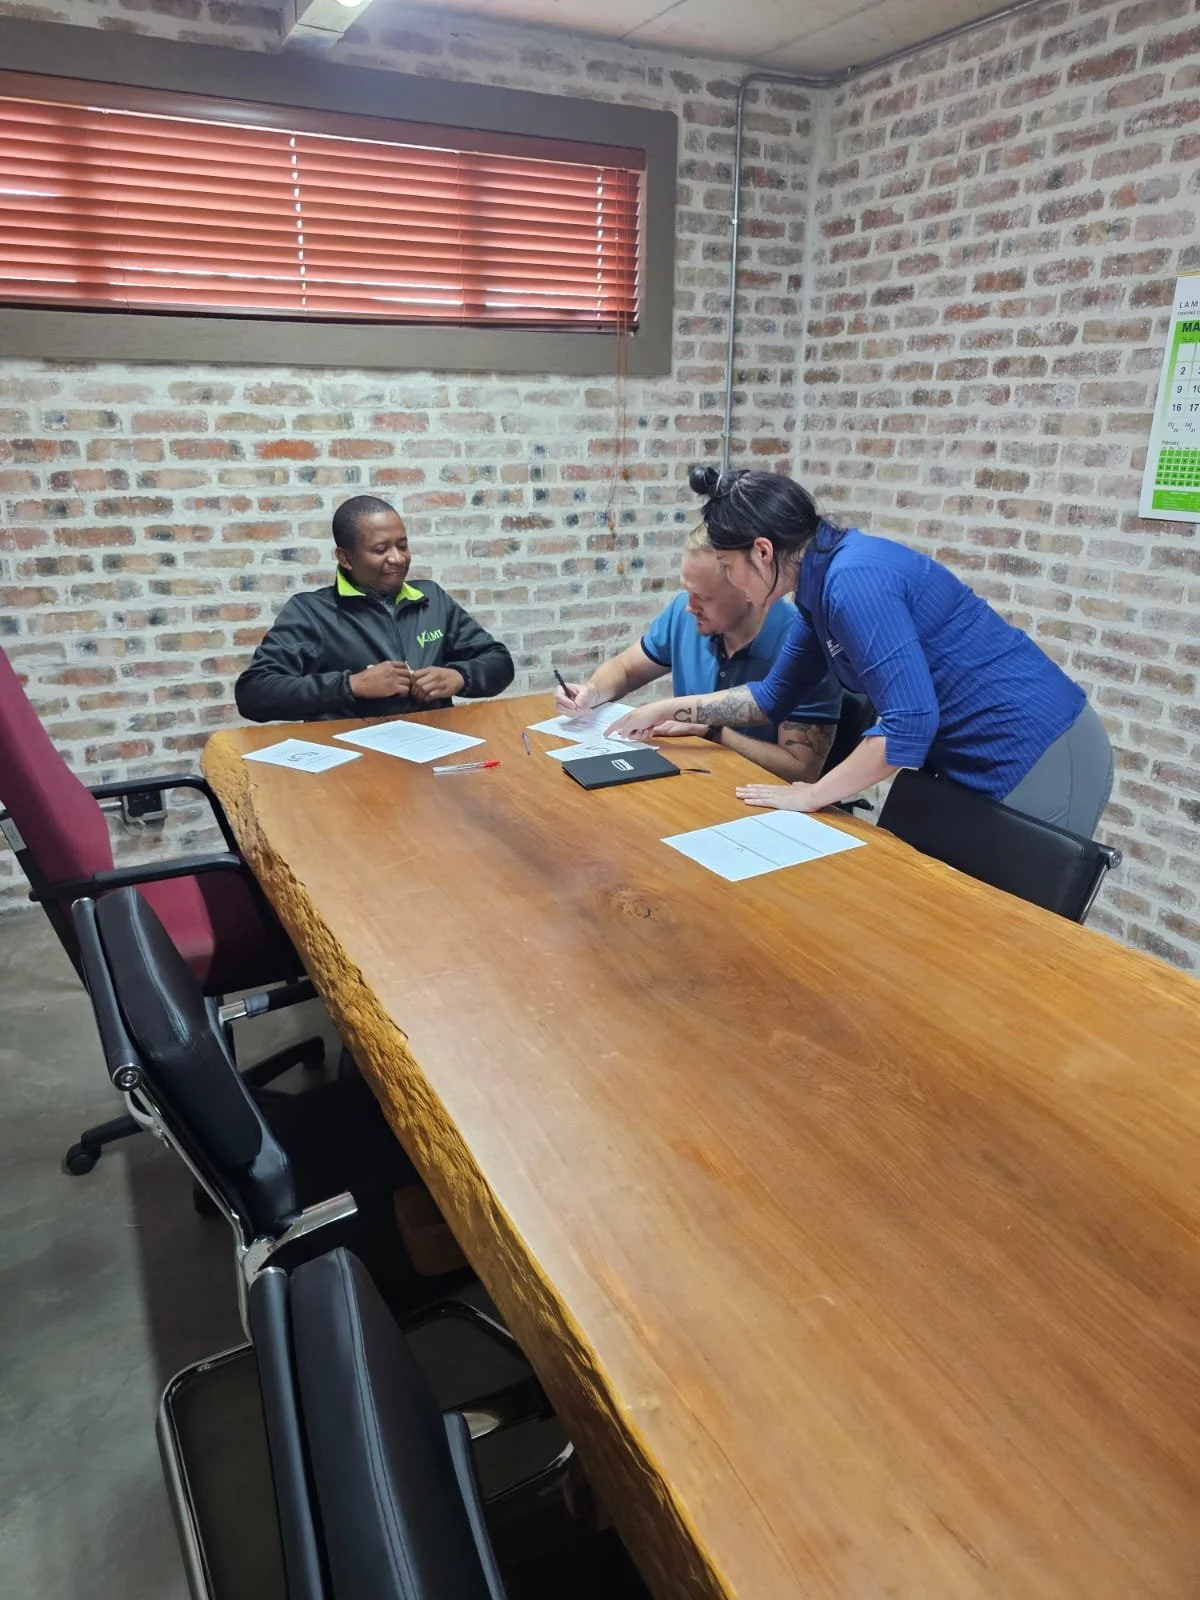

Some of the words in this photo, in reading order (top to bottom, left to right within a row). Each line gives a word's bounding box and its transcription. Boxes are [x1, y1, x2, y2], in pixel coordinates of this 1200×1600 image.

[1180, 366, 1186, 375] 2
[1177, 385, 1183, 394] 9
[1172, 403, 1182, 412] 16
[1190, 403, 1200, 412] 17
